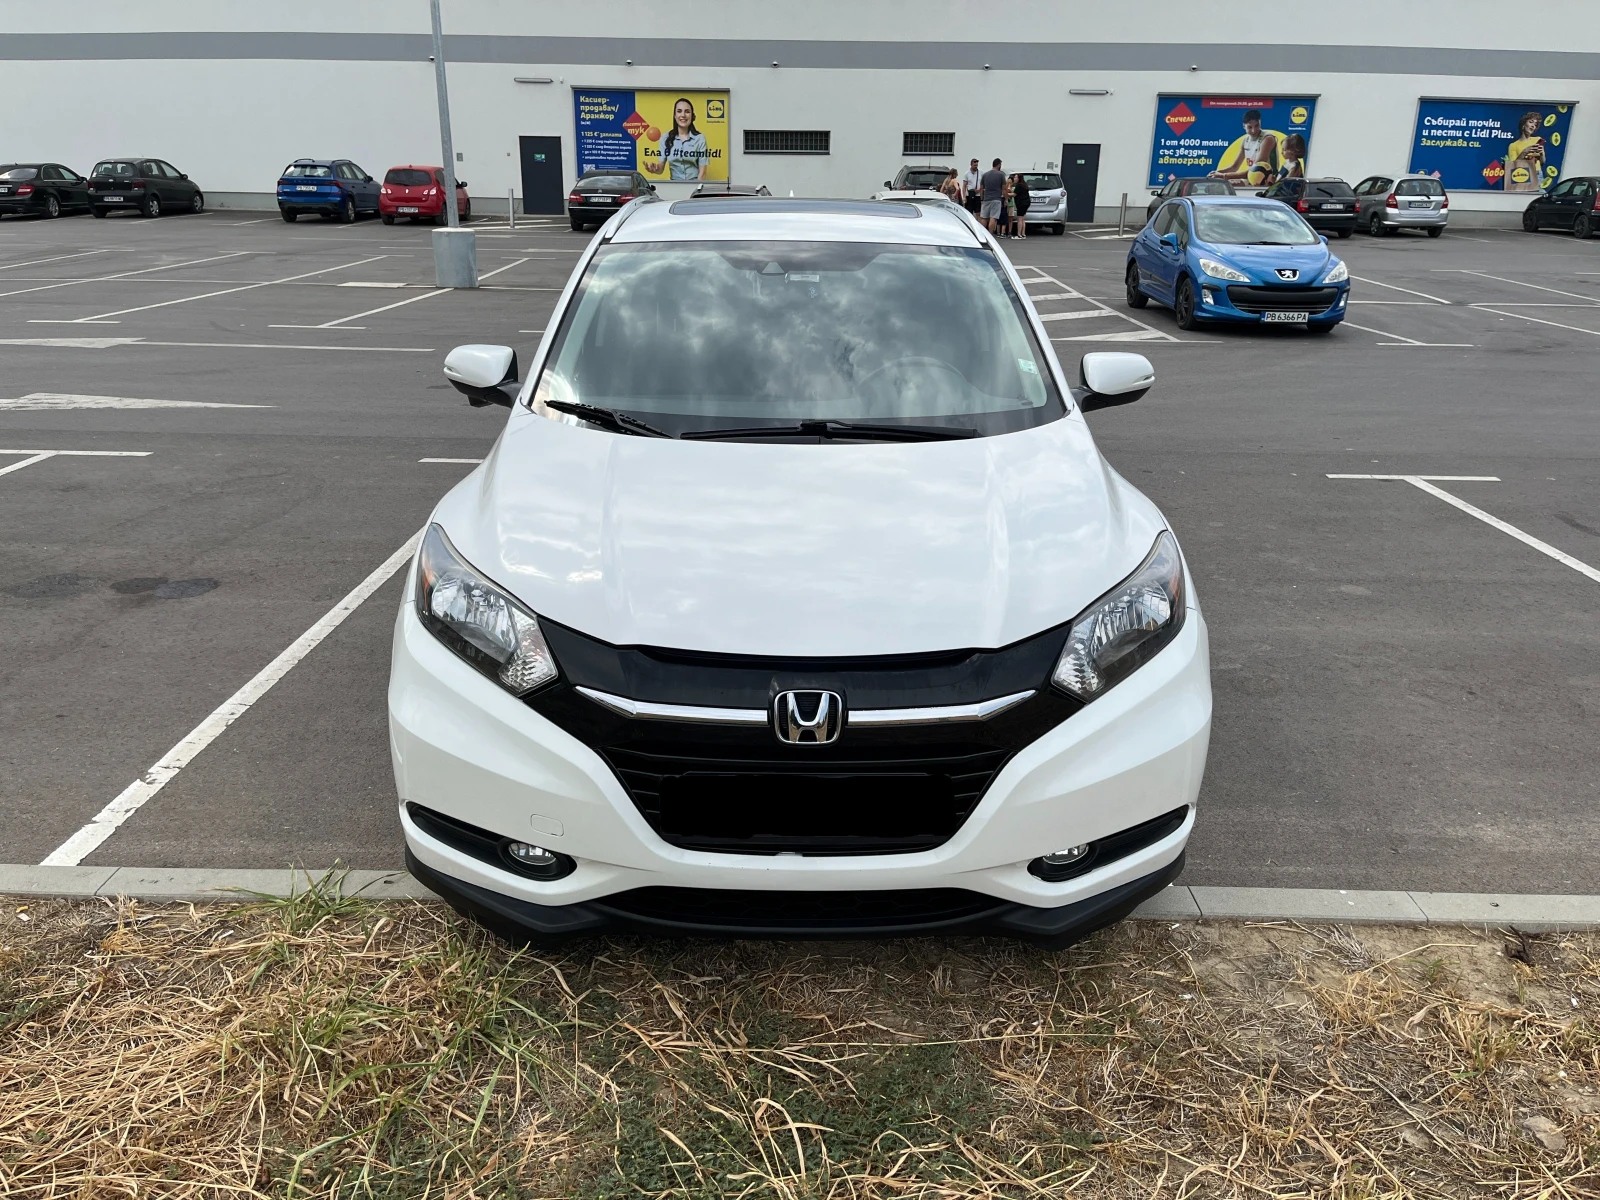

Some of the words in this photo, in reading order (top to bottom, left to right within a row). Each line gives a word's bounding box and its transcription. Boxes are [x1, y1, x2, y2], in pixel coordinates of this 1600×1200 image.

[580, 96, 609, 104] Касиер-
[580, 104, 619, 112] продавач/
[580, 112, 614, 120] Аранжор
[1424, 117, 1466, 128] Събирай
[1468, 119, 1500, 128] точки
[628, 126, 644, 135] тук
[1472, 129, 1489, 138] Lidl
[1491, 130, 1514, 138] Plus.
[1421, 138, 1467, 148] Заслужава
[644, 148, 662, 156] Ела
[665, 148, 670, 156] в
[673, 148, 721, 158] #teamlidl
[1175, 148, 1208, 157] звездни
[1158, 156, 1212, 166] автографи
[1483, 168, 1504, 177] Ново
